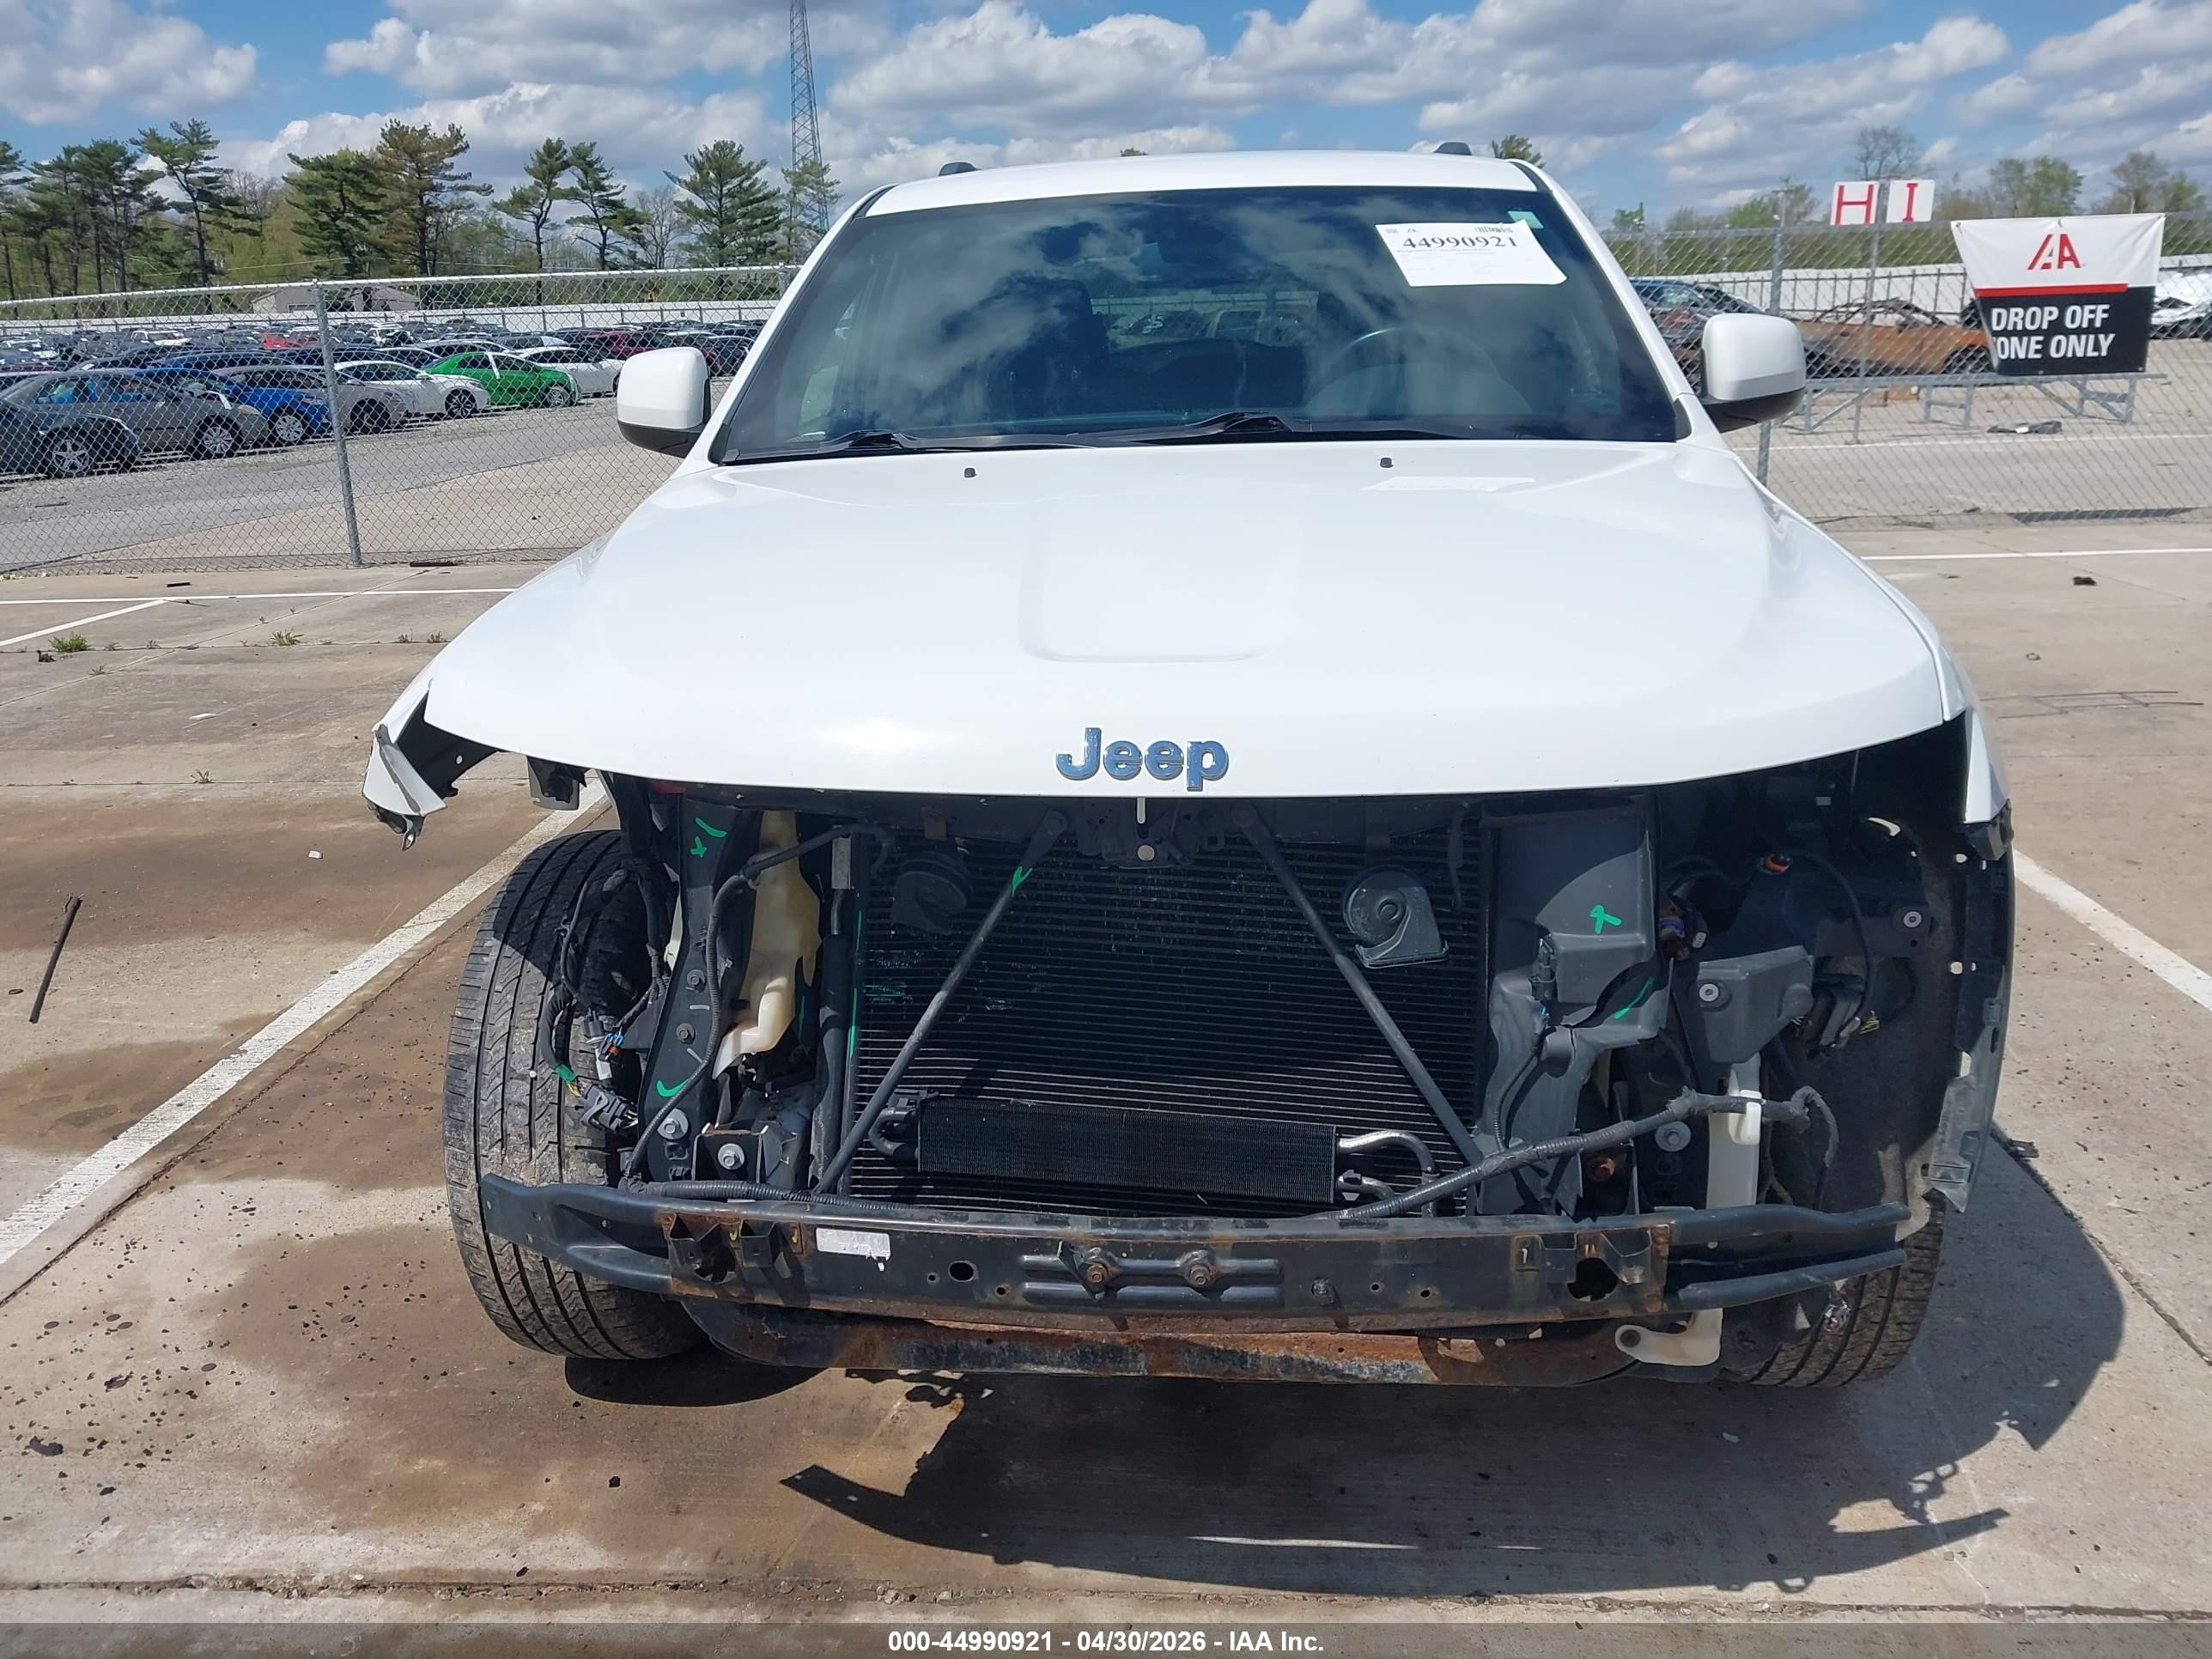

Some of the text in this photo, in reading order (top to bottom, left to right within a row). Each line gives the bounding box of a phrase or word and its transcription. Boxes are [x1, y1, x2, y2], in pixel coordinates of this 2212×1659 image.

[1403, 235, 1518, 248] 44990921
[1991, 304, 2111, 331] DROP OFF
[1992, 332, 2117, 360] ONE ONLY
[1056, 726, 1230, 792] Jeep
